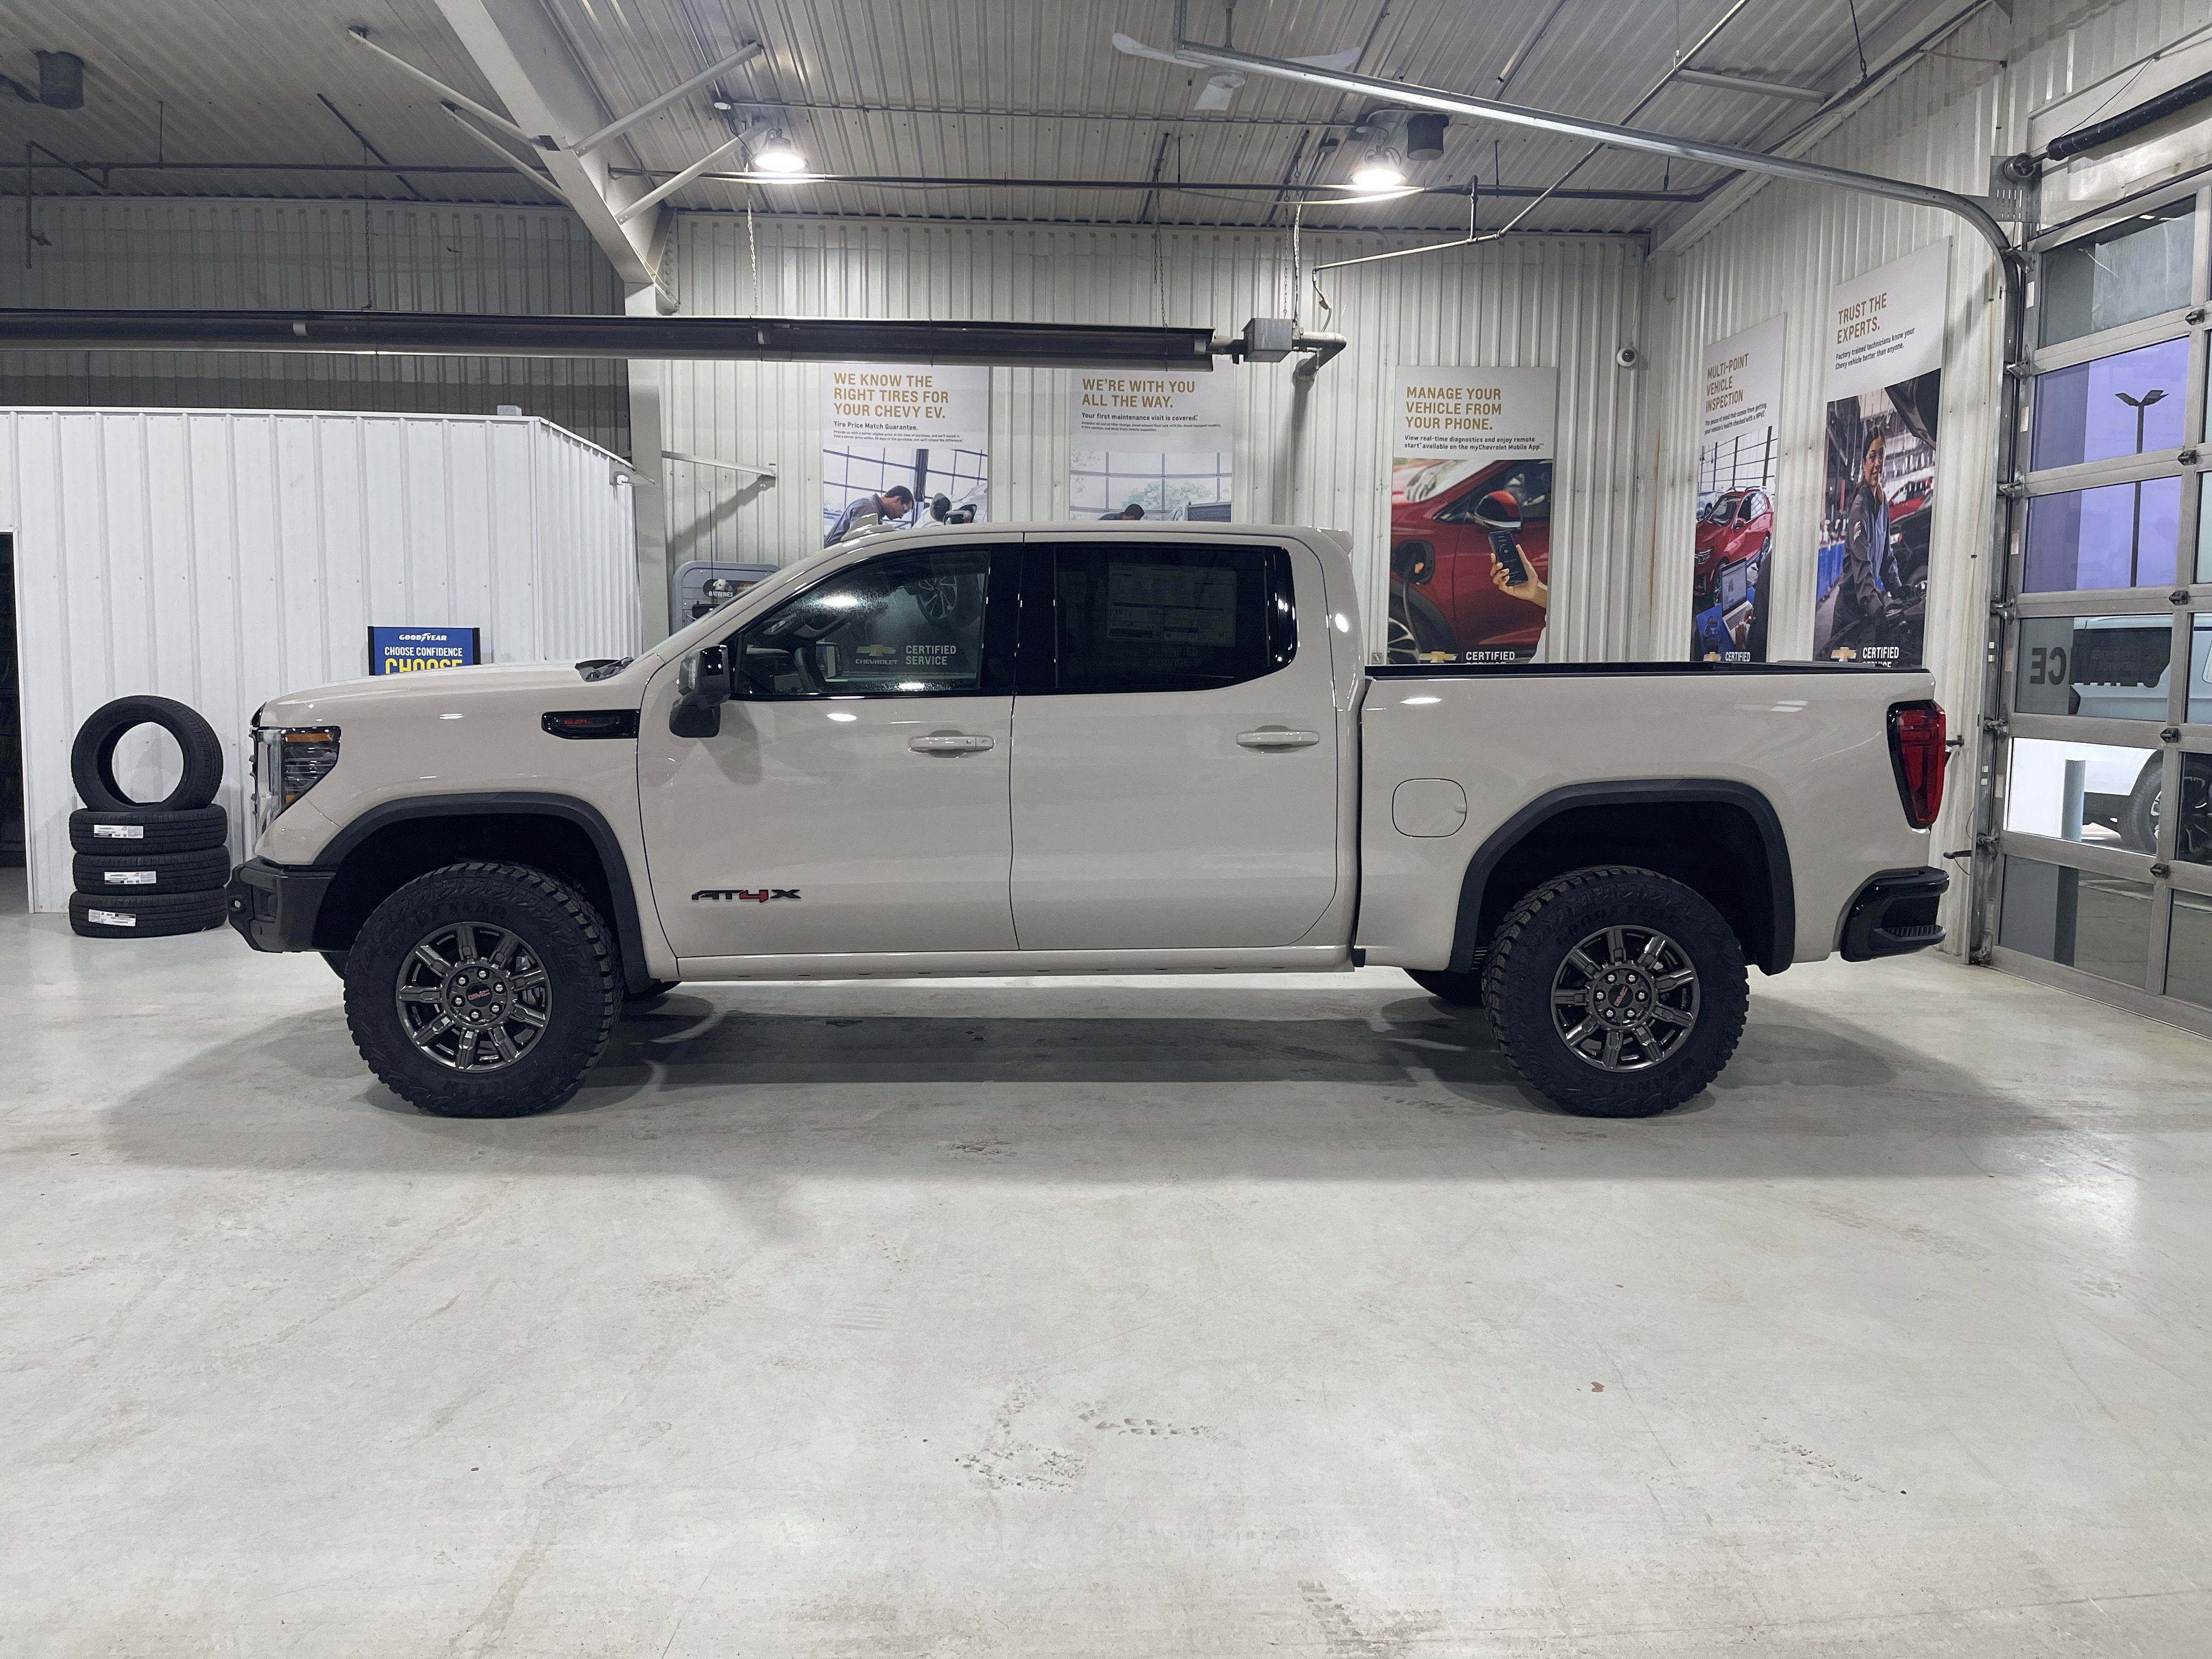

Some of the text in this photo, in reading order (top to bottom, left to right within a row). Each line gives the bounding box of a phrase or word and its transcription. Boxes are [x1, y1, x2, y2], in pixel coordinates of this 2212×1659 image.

[1838, 292, 1887, 325] TRUST THE
[1837, 316, 1880, 345] EXPERTS.
[1836, 328, 1915, 360] Factory trained technicians know your
[1835, 342, 1904, 370] Chevy vehicle better than anyone.
[1707, 353, 1749, 380] MULTI-POINT
[834, 373, 932, 387] WE KNOW THE
[1082, 379, 1195, 393] WE'RE WITH YOU
[1707, 376, 1733, 396] VEHICLE
[834, 388, 949, 403] RIGHT TIRES FOR
[1082, 393, 1173, 408] ALL THE WAY.
[1407, 387, 1501, 400] MANAGE YOUR
[1706, 389, 1743, 413] INSPECTION
[834, 403, 945, 419] YOUR CHEVY EV.
[1406, 402, 1502, 415] VEHICLE FROM
[1406, 416, 1493, 430] YOUR PHONE.
[399, 633, 447, 642] GOODYEAR
[385, 646, 462, 657] CHOOSE CONFIDENCE
[906, 645, 956, 654] CERTIFIED
[1466, 651, 1515, 660] CERTIFIED
[1863, 647, 1899, 659] CERTIFIED
[905, 656, 947, 665] SERVICE
[1725, 652, 1750, 662] CERTIFIED
[691, 889, 801, 903] AT4X
[468, 989, 490, 1001] GMC
[1614, 986, 1628, 1007] GMC
